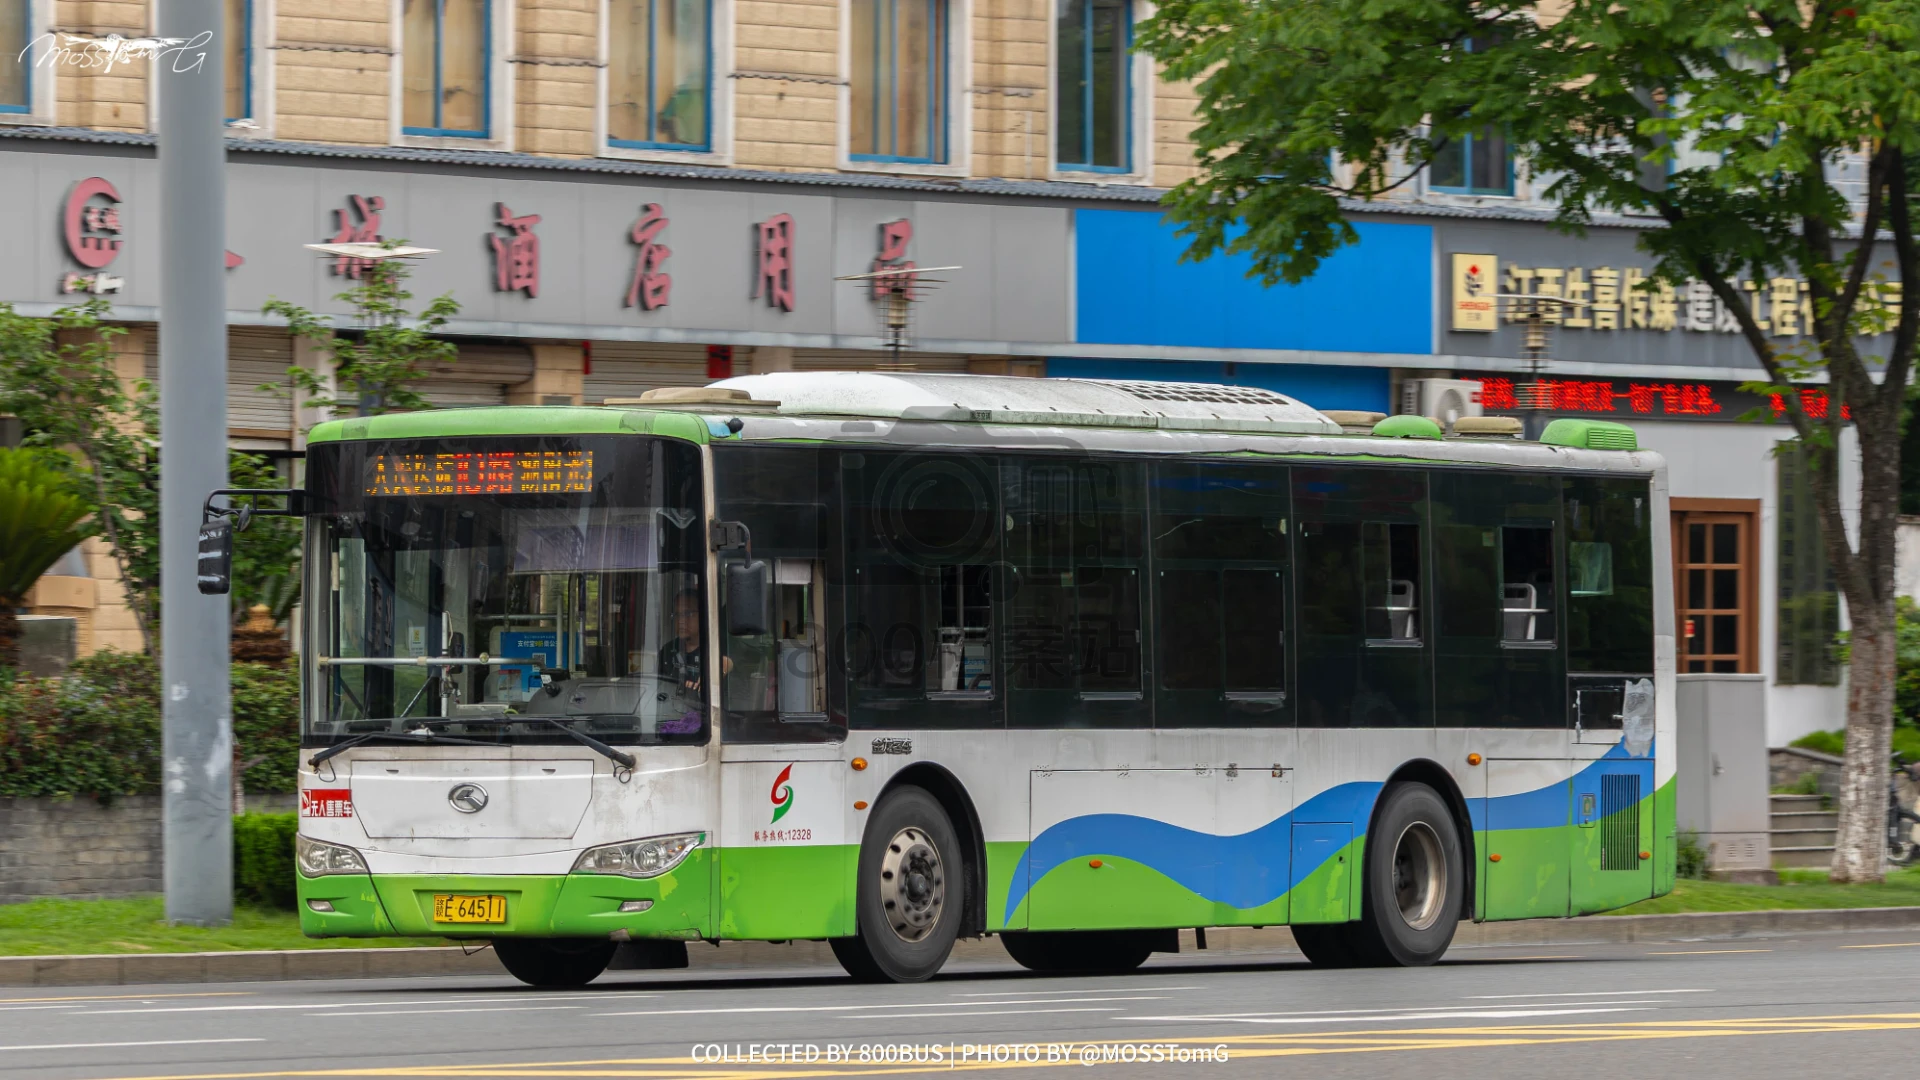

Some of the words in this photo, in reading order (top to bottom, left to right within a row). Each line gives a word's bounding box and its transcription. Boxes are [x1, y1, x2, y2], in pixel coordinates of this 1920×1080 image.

[310, 799, 352, 817] 无人售票车
